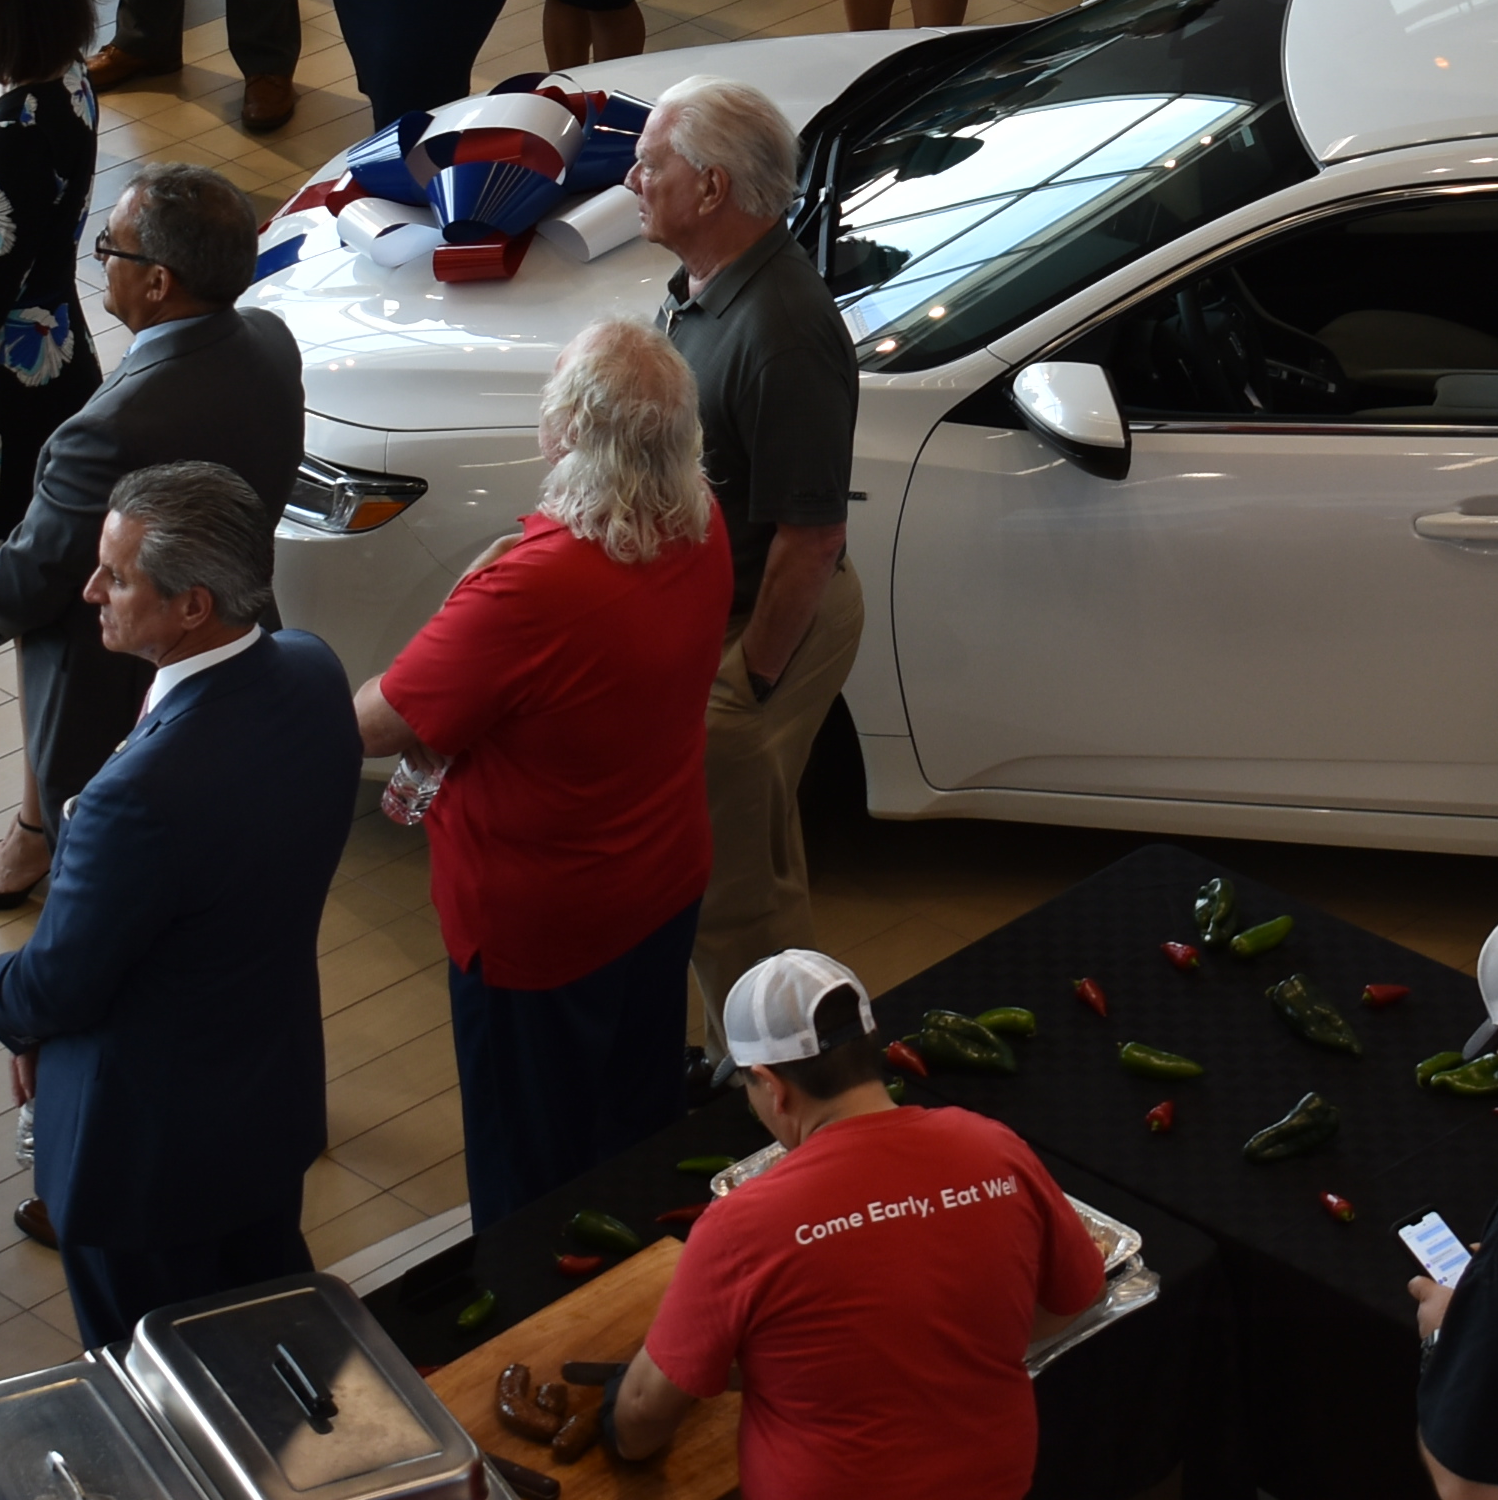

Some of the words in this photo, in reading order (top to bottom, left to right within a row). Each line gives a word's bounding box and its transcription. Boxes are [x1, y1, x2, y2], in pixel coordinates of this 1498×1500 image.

[795, 1211, 864, 1245] Come
[867, 1196, 935, 1223] Early,
[940, 1185, 981, 1209] Eat
[982, 1175, 1018, 1199] Well
